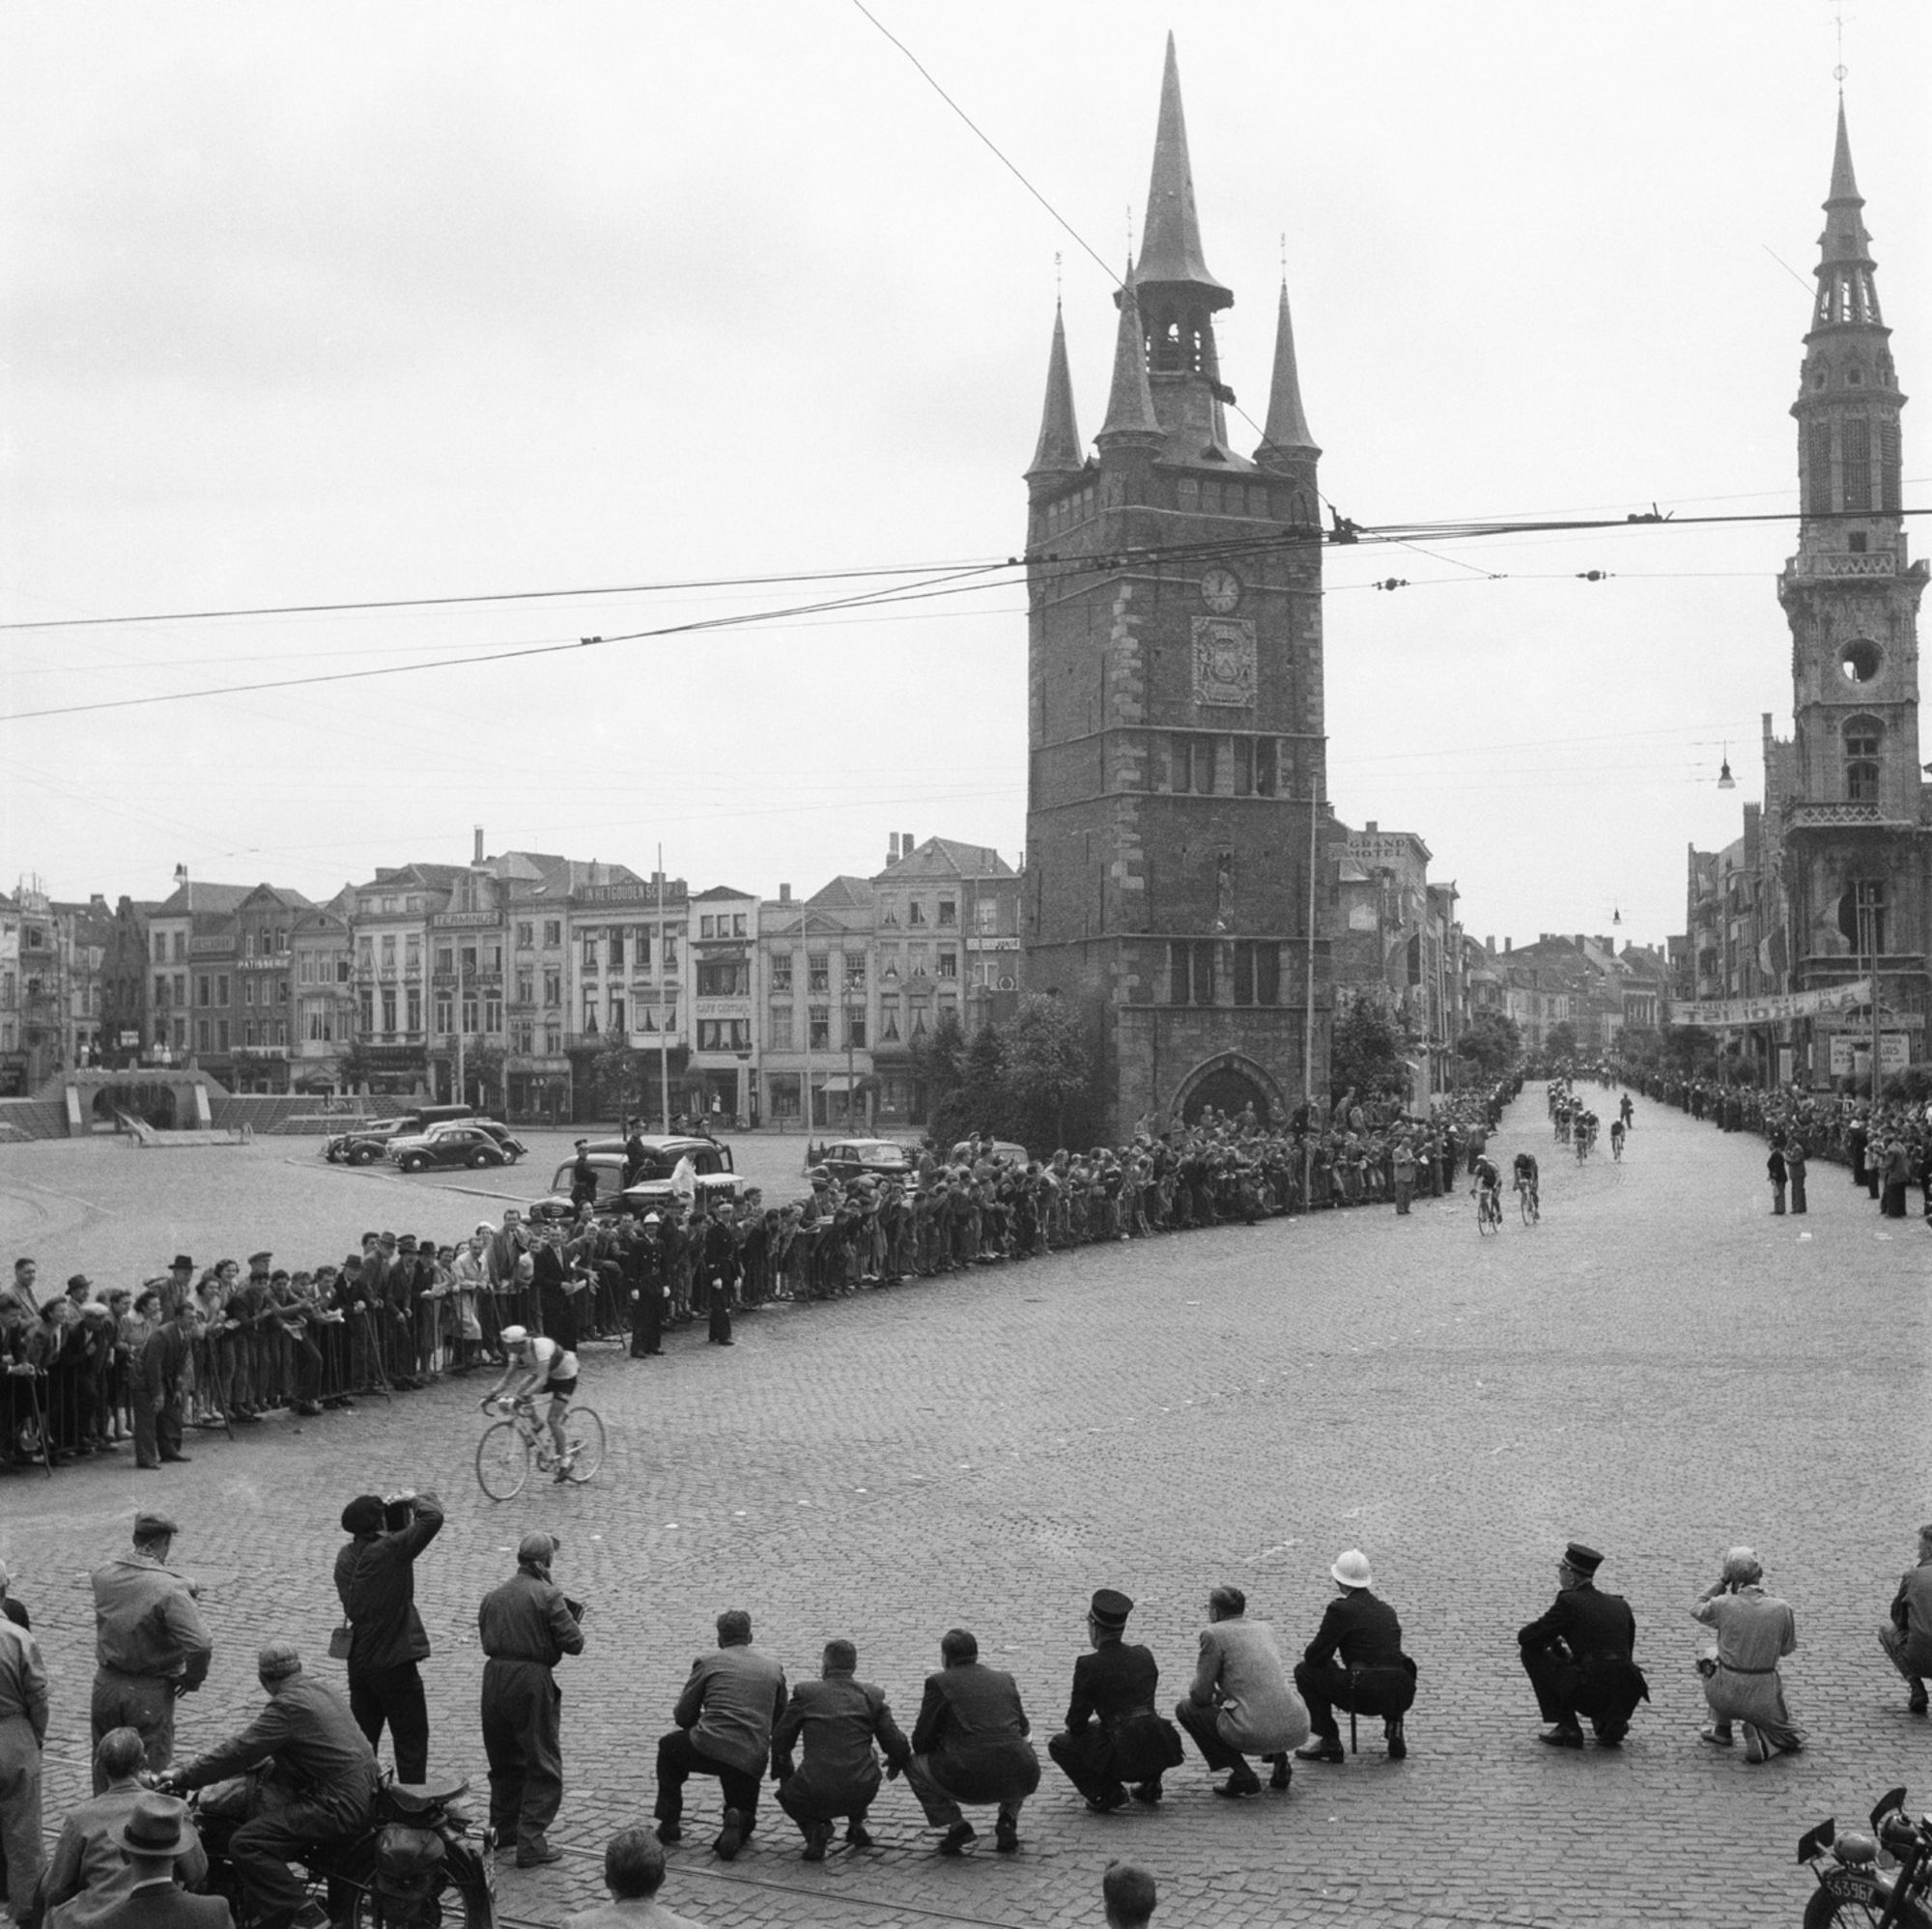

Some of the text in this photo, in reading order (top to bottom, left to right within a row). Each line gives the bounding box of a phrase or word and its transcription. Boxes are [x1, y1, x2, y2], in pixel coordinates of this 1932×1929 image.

[1350, 838, 1406, 848] GRAND
[1350, 849, 1406, 858] HOTEL
[611, 884, 644, 900] GOUDEN
[646, 883, 672, 898] SCIP
[437, 912, 497, 925] TERMINUS
[238, 958, 289, 970] PATISSERIE
